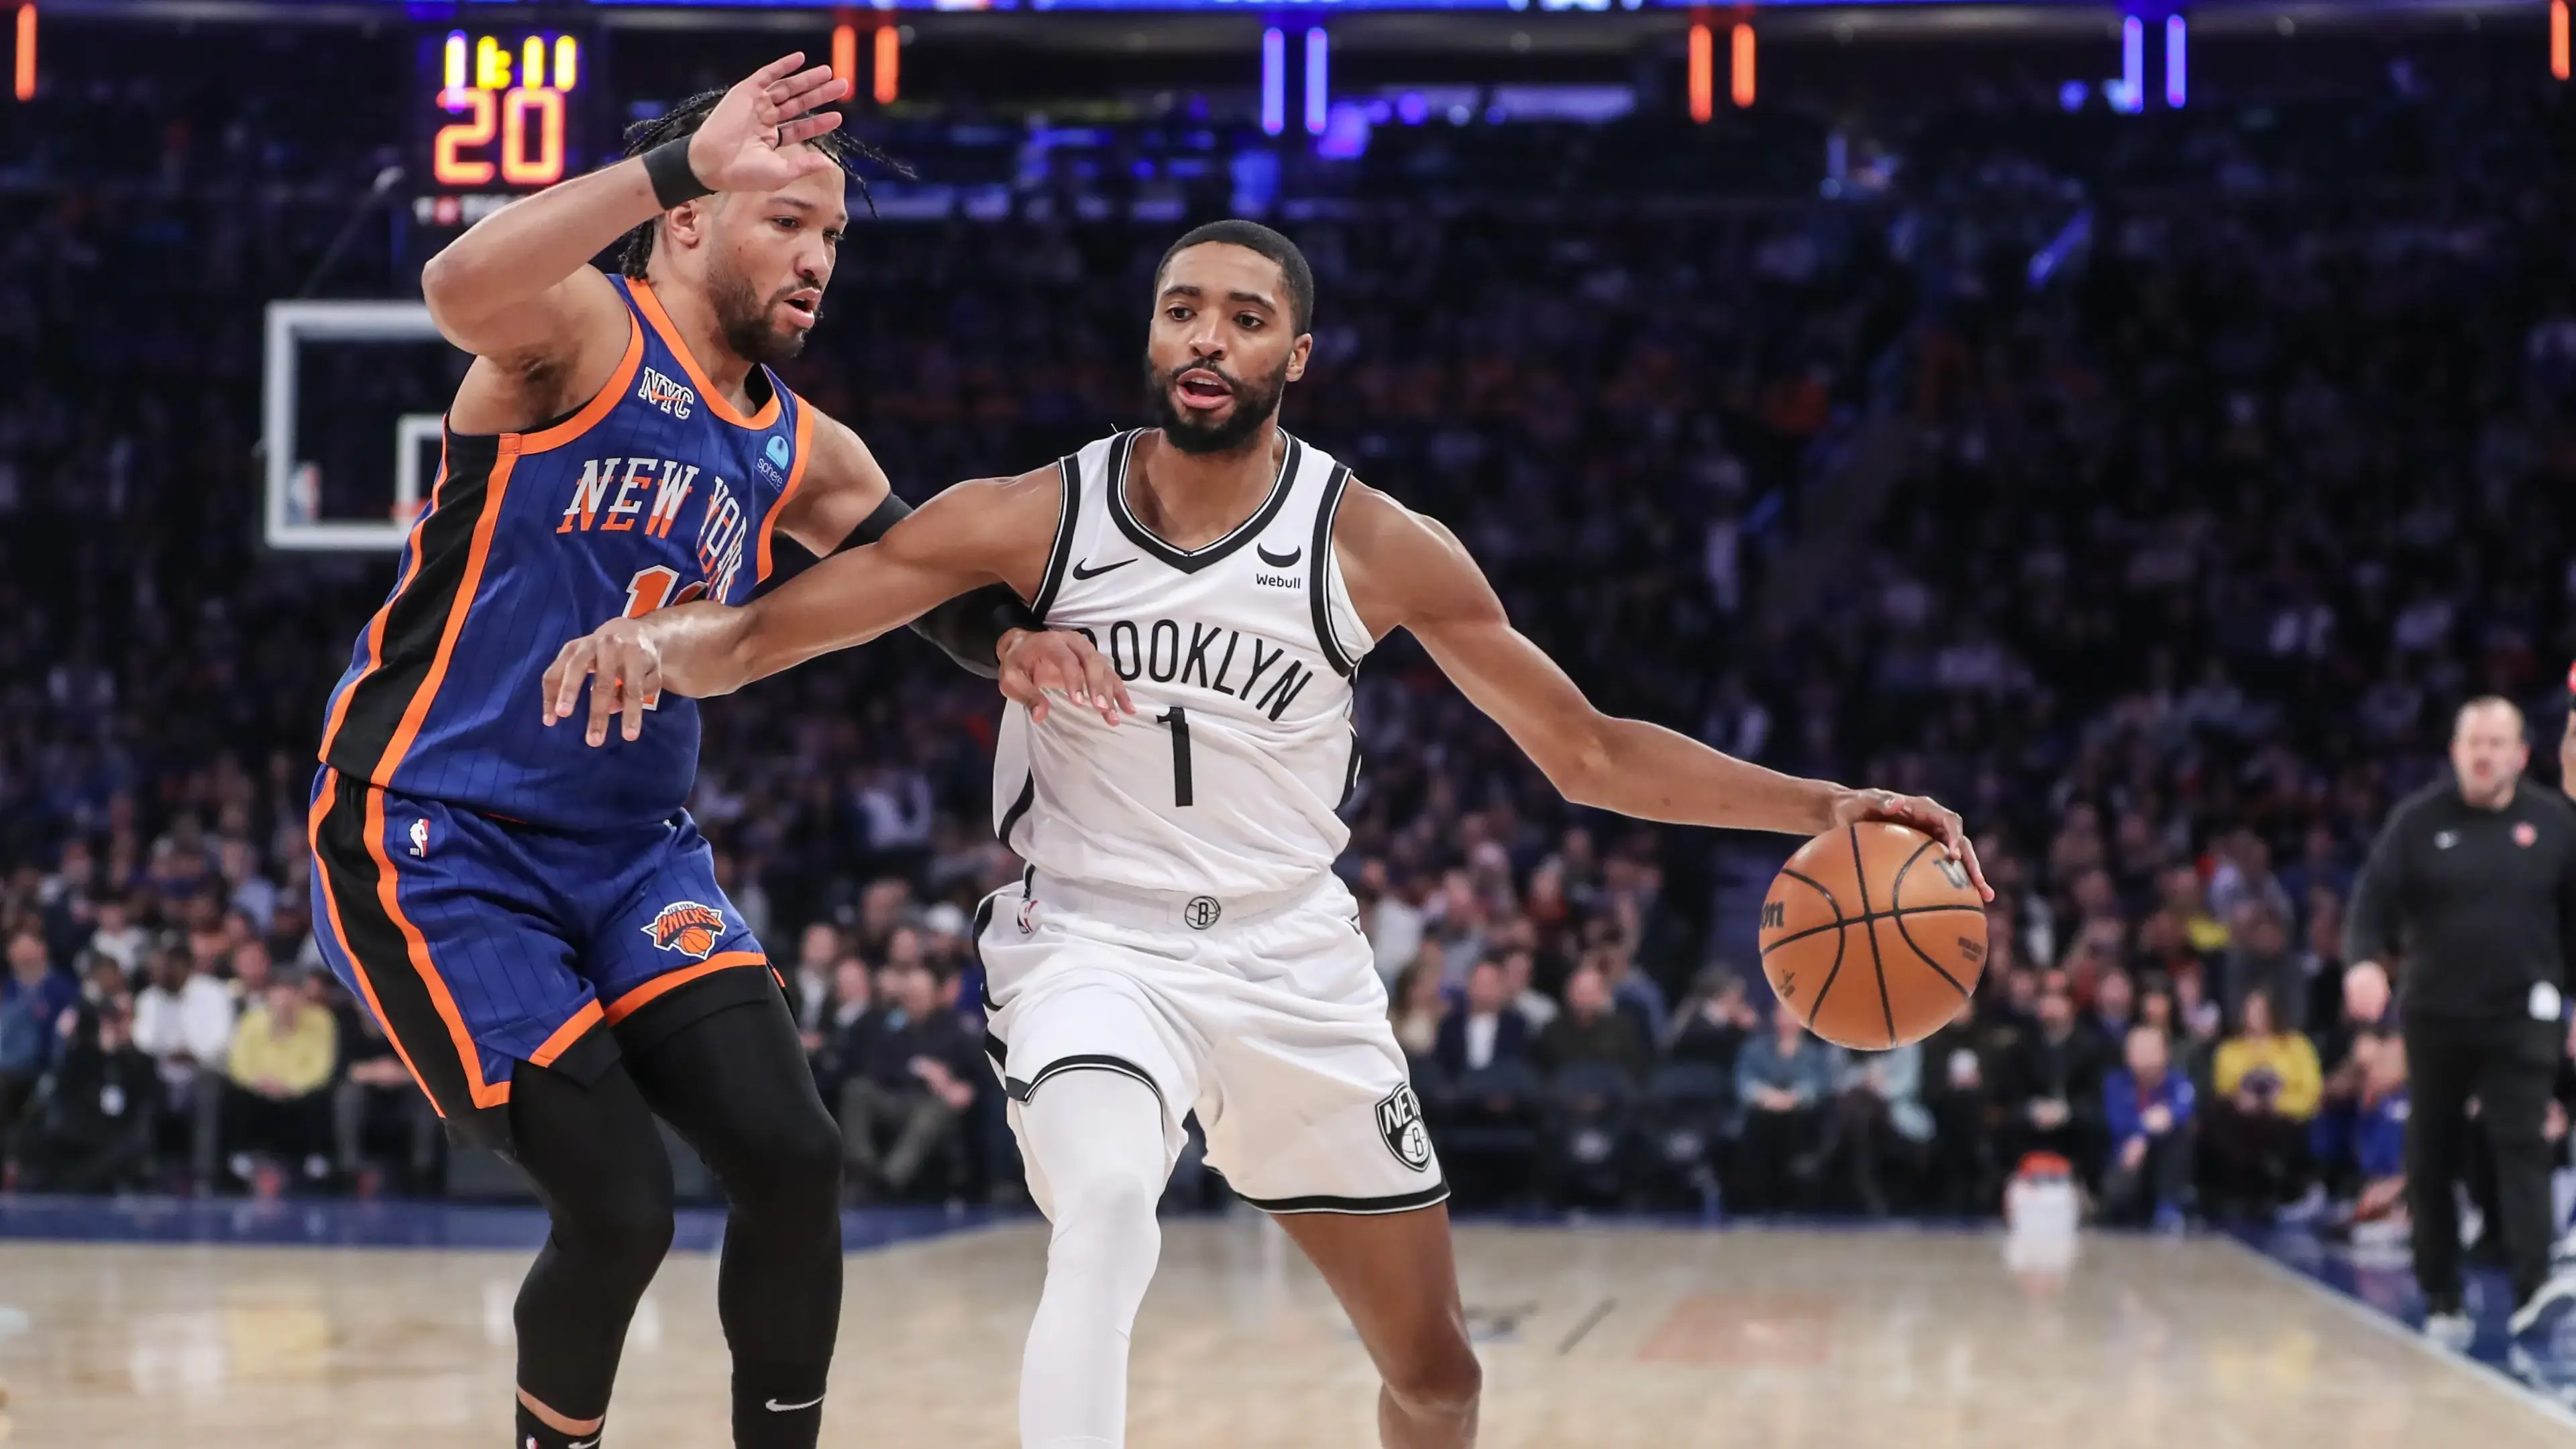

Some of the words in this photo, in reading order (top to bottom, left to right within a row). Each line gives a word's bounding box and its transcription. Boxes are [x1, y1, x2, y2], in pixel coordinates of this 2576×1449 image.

[434, 87, 566, 184] 20
[638, 366, 694, 420] NYC
[757, 458, 783, 487] sphere
[557, 458, 699, 538] NEW
[697, 476, 747, 605] YORK
[1256, 573, 1301, 589] Webull
[1156, 706, 1193, 807] 1
[657, 907, 723, 945] KNICKS
